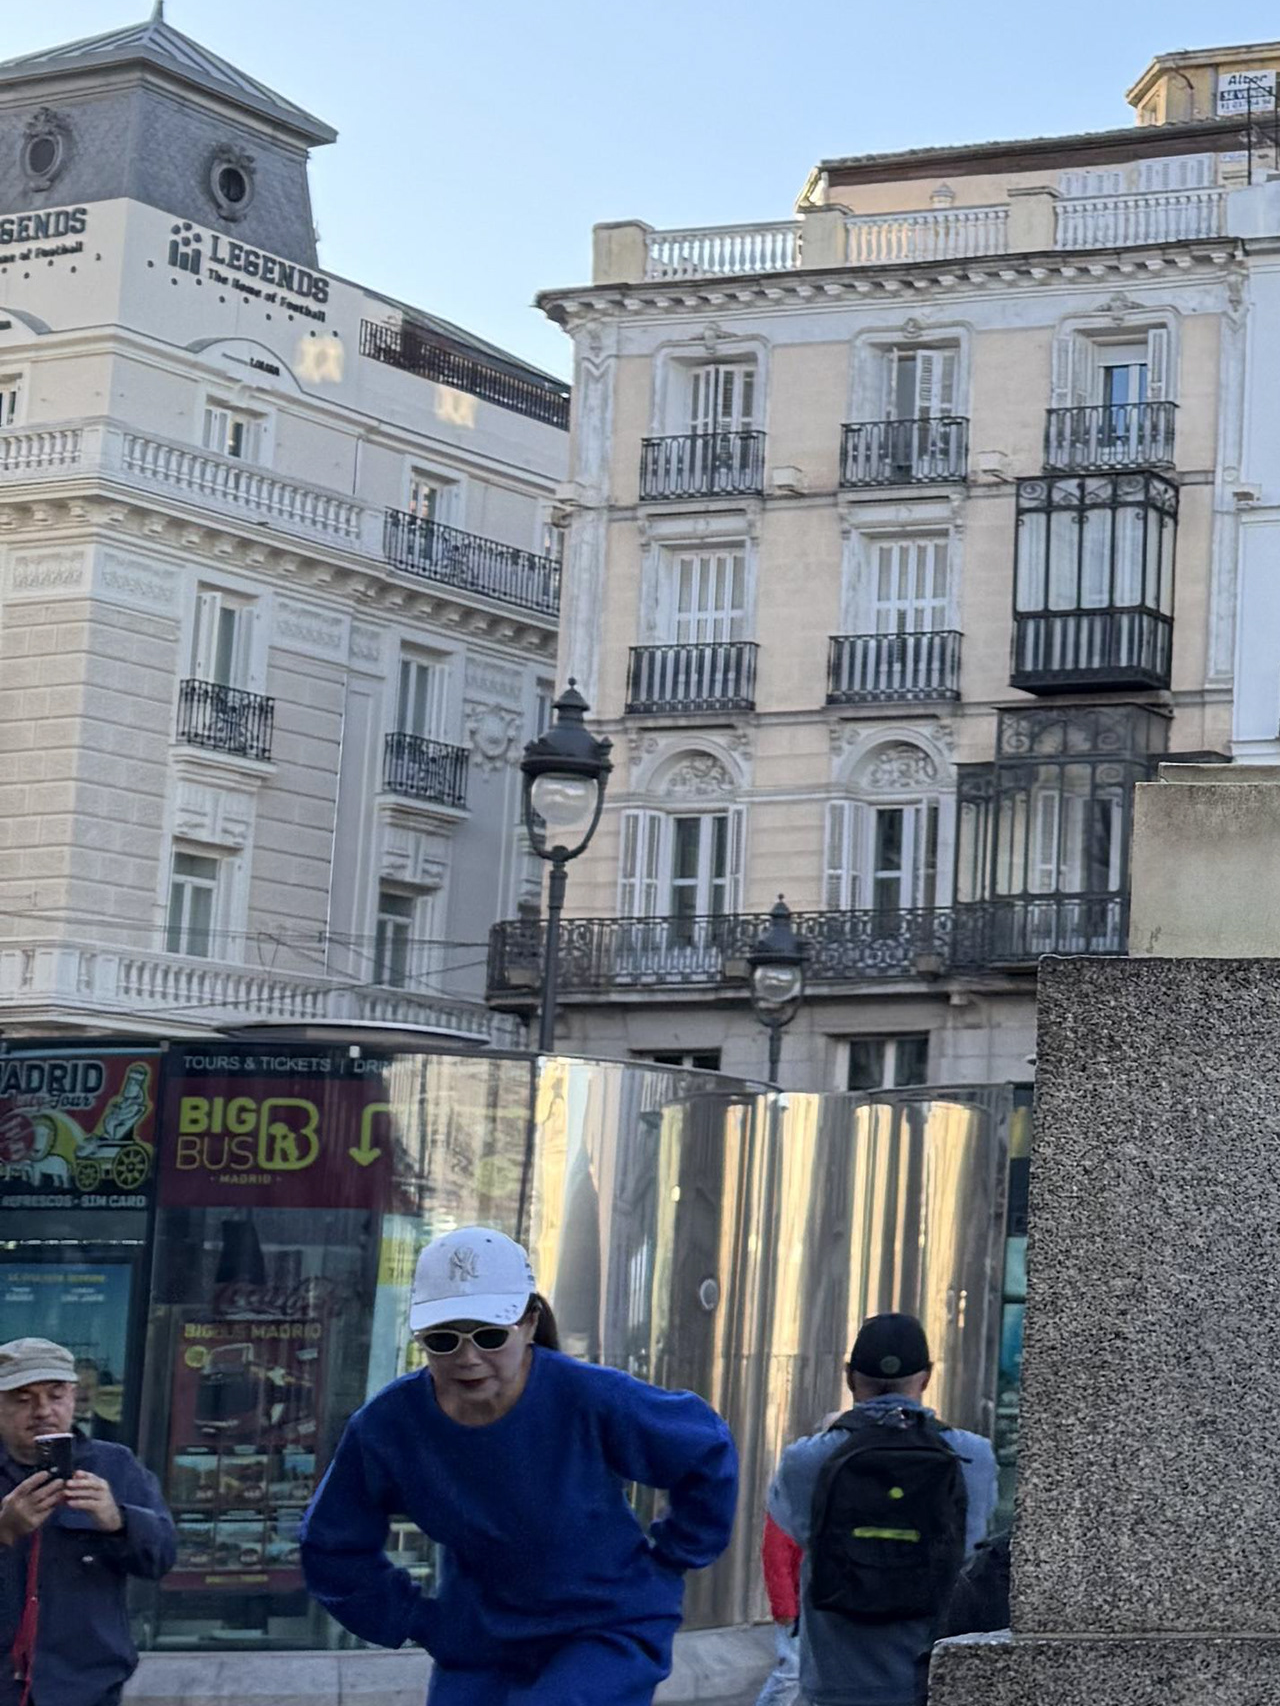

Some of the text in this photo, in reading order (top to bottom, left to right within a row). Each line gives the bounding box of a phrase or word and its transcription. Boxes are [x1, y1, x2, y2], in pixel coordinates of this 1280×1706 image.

[209, 233, 330, 304] LEGENDS
[208, 267, 327, 324] The Home of Football
[0, 1062, 104, 1093] ADRID
[183, 1054, 240, 1070] TOURS
[244, 1056, 256, 1070] &
[258, 1055, 331, 1072] TICKETS
[179, 1096, 257, 1135] BIG
[175, 1135, 254, 1171] BUS
[219, 1173, 272, 1185] MADRID
[109, 1195, 147, 1207] CARD
[251, 1322, 322, 1339] MADRID
